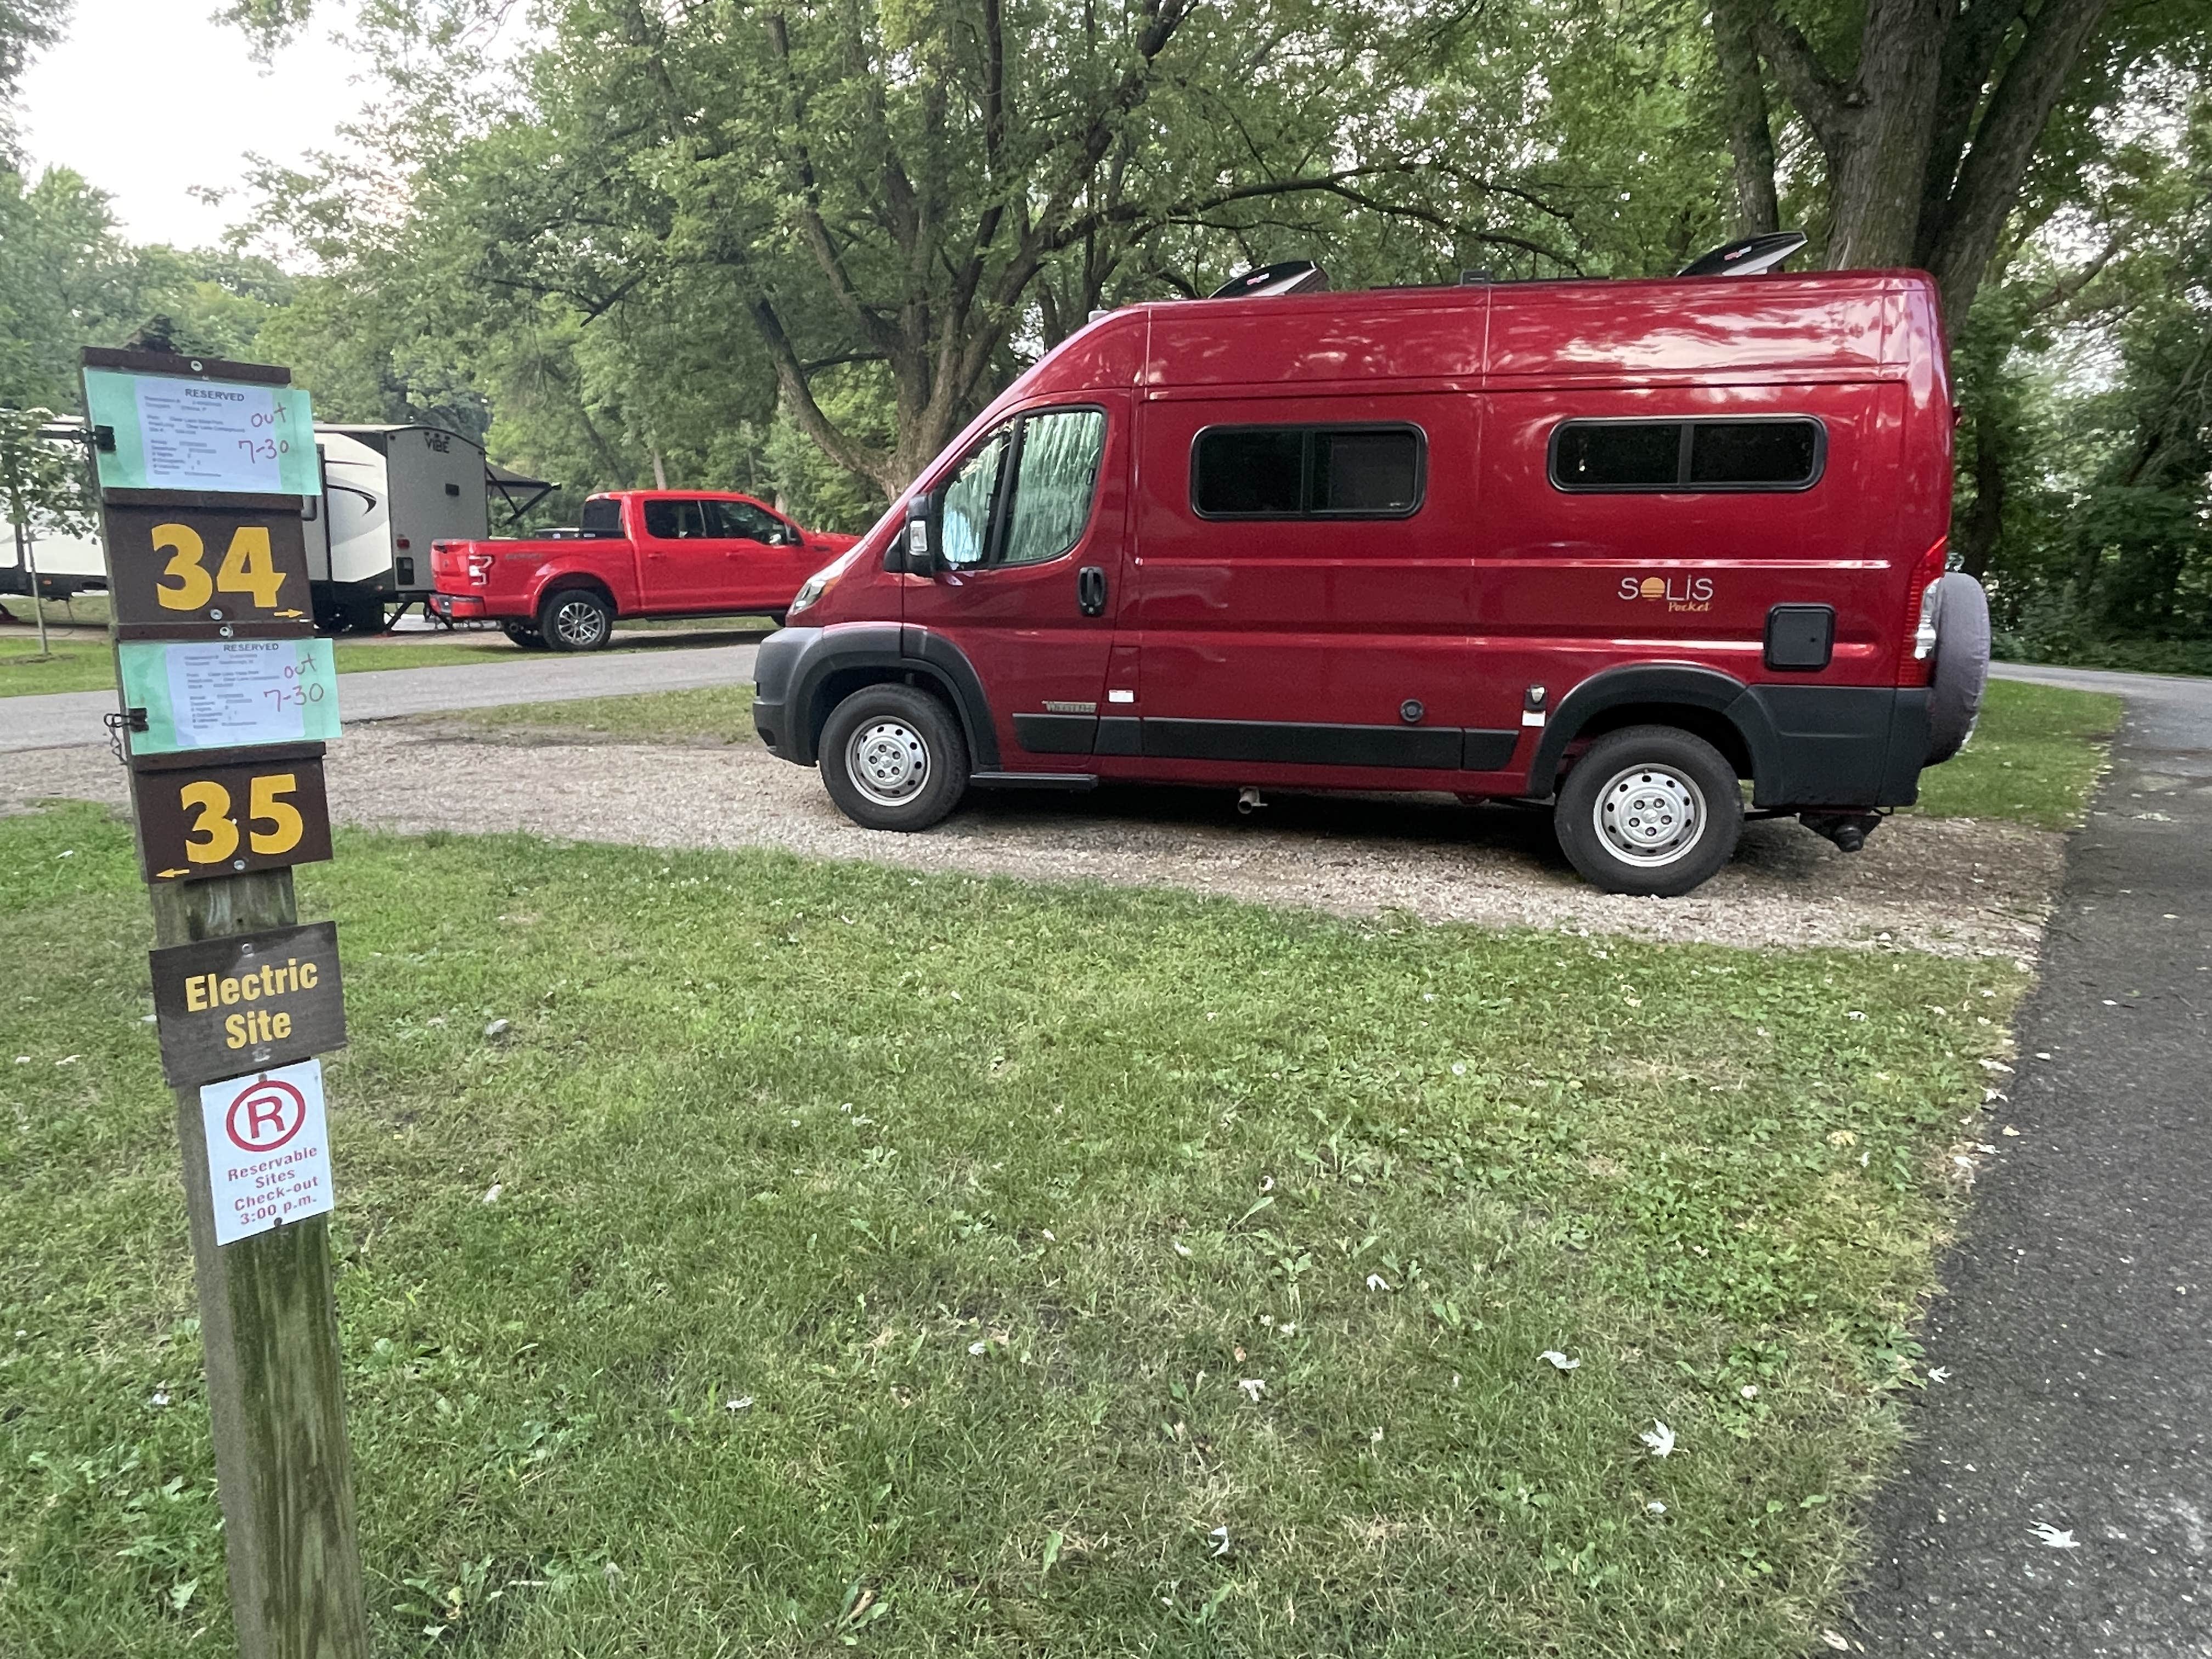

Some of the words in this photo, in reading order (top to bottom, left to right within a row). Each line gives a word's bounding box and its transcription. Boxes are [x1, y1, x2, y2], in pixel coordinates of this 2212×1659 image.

[185, 388, 245, 402] RESERVED
[238, 439, 290, 464] 7-30
[425, 437, 449, 454] VIBE
[151, 523, 286, 610] 34
[1668, 601, 1709, 612] Pocket
[224, 643, 279, 652] RESERVED
[263, 682, 324, 712] 7-30
[180, 774, 303, 864] 35
[185, 958, 318, 1012] Electric
[225, 1009, 291, 1049] Site
[228, 1147, 318, 1182] Reservable
[255, 1169, 295, 1188] Sites
[234, 1176, 319, 1211] Check-out
[240, 1204, 276, 1226] 3:00
[284, 1194, 317, 1214] p.m.
